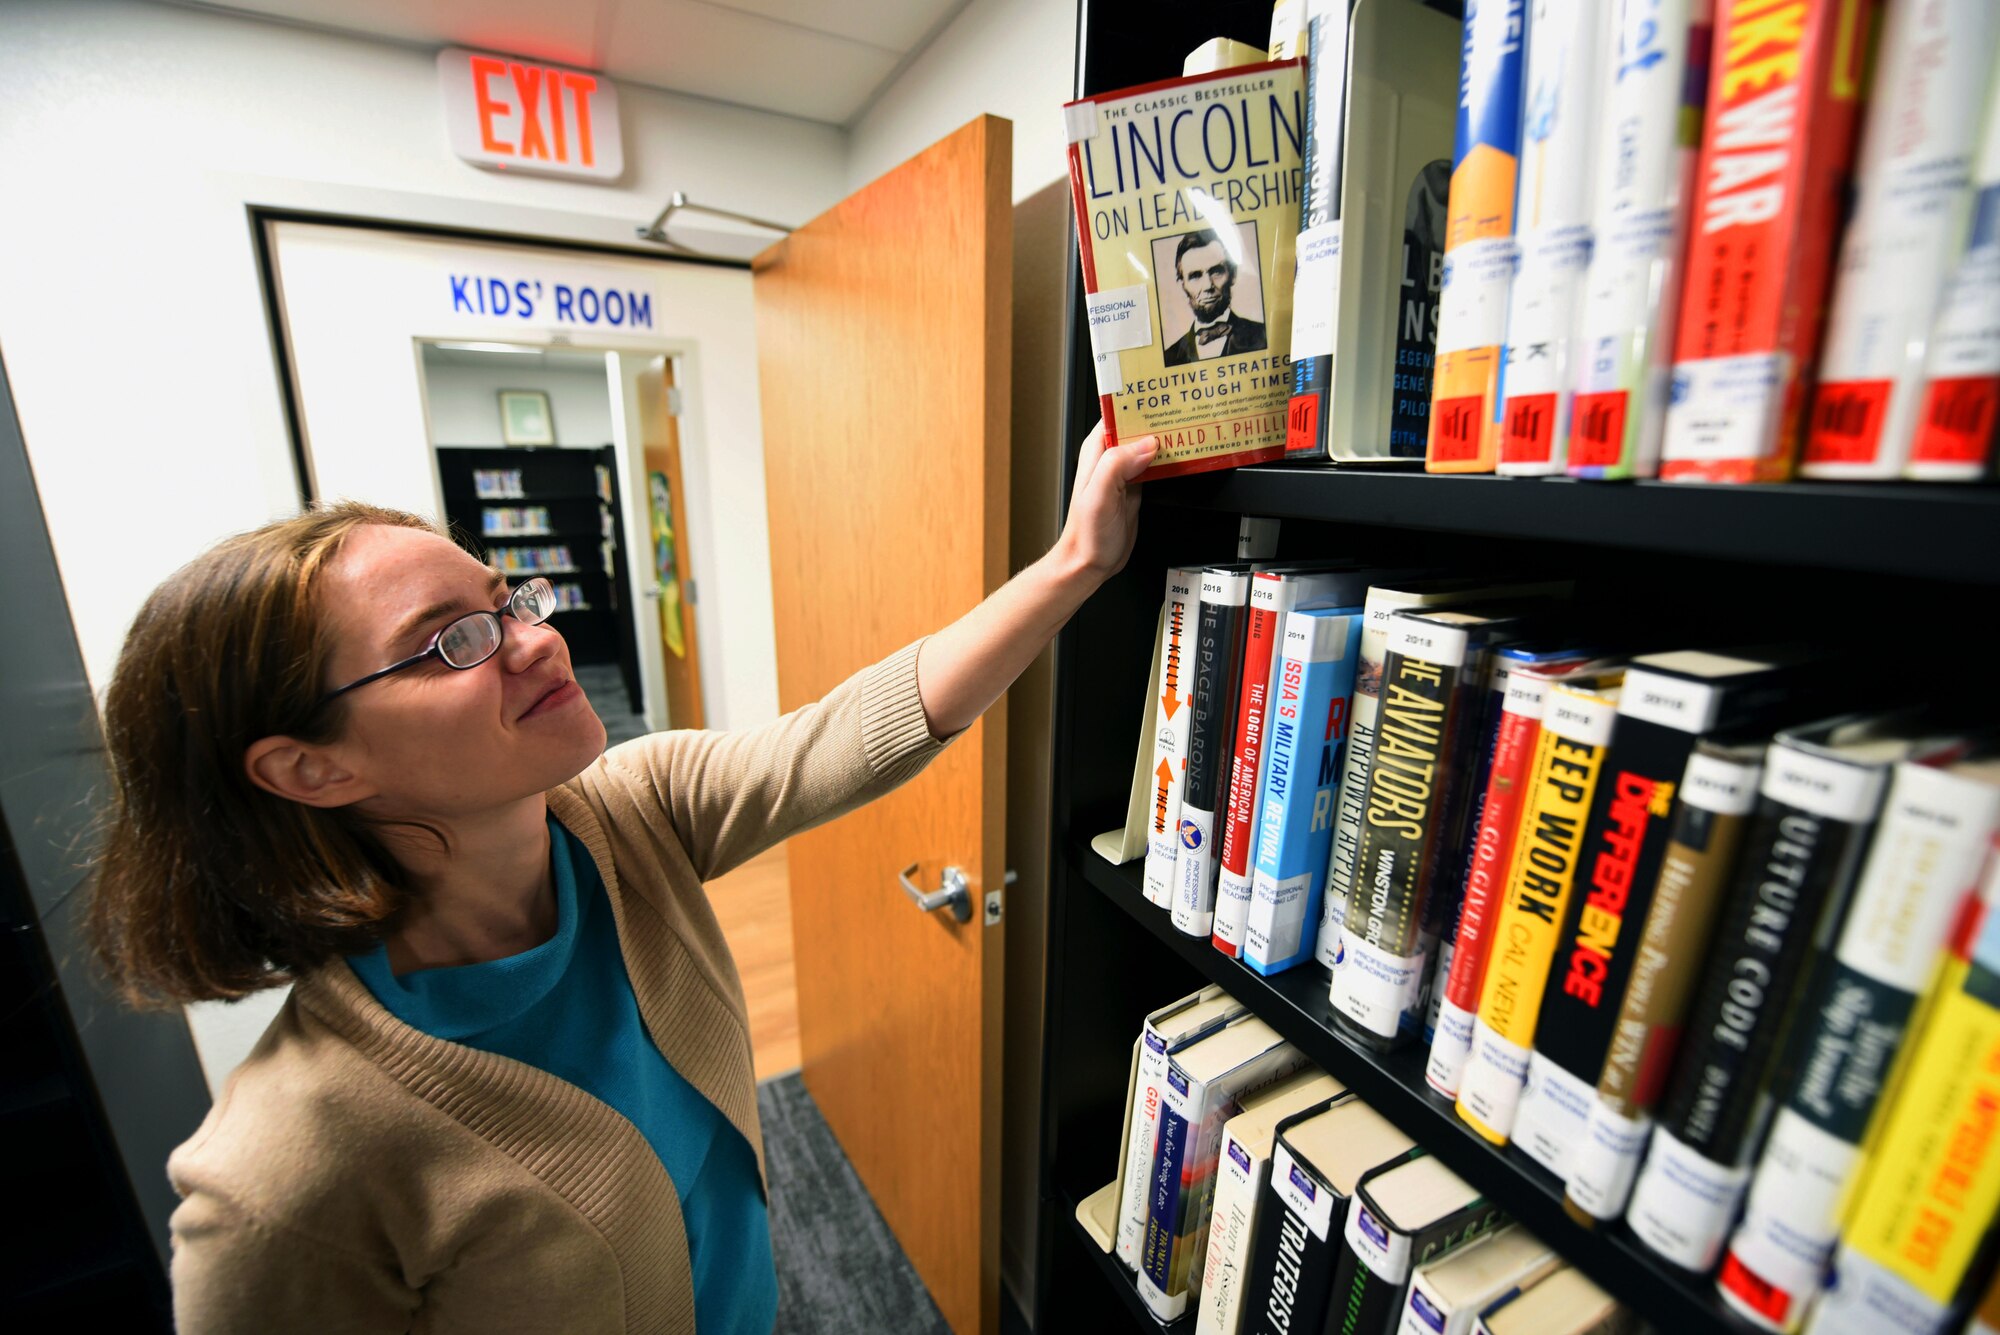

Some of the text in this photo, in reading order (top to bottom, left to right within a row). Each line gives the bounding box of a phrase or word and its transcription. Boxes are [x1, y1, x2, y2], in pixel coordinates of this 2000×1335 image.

[469, 55, 597, 168] EXIT
[1104, 79, 1274, 120] THE CLASSIC BESTSELLER
[1084, 90, 1301, 199] LINCOLN
[1095, 205, 1129, 240] ON
[450, 273, 653, 328] KIDS' ROOM
[1113, 311, 1131, 321] LIST
[1137, 394, 1170, 410] FOR
[1180, 381, 1241, 403] TOUGH
[1150, 419, 1174, 429] delivers
[1175, 413, 1211, 424] uncommon
[1213, 411, 1229, 419] good
[1198, 403, 1213, 412] lively
[1228, 393, 1267, 406] entertaining
[1172, 585, 1189, 595] 2018
[1203, 584, 1222, 593] 2018
[1253, 590, 1273, 600] 2018
[1288, 632, 1305, 640] 2018
[1405, 634, 1432, 648] 2018
[1166, 643, 1181, 691] KELLY
[1197, 636, 1215, 703] SPACE
[1190, 709, 1207, 791] BARONS
[1237, 684, 1264, 823] THE LOGIC OF AMERICAN
[1269, 721, 1294, 799] MILITARY
[1341, 722, 1374, 831] AIRPOWER
[1366, 684, 1445, 840] AVIATORS
[1156, 787, 1168, 812] THE
[1221, 756, 1242, 865] NUCLEAR STRATEGY
[1260, 800, 1284, 866] REVIVAL
[1191, 860, 1199, 911] PROFESSIONAL
[1260, 883, 1303, 898] PROFESSIONAL
[1370, 848, 1395, 918] WINSTON
[1462, 825, 1500, 940] GO-GIVER
[1518, 811, 1577, 925] WORK
[1564, 770, 1656, 1007] DIFFERENCE
[1259, 891, 1285, 905] READING
[1503, 922, 1533, 968] CAL
[1713, 957, 1770, 1051] CODE
[1144, 1086, 1158, 1121] GRIT
[1158, 1118, 1177, 1210] You for Being Late
[1289, 1191, 1308, 1212] 2017
[1205, 1211, 1226, 1289] On China
[1216, 1203, 1246, 1330] Henry Kissinger
